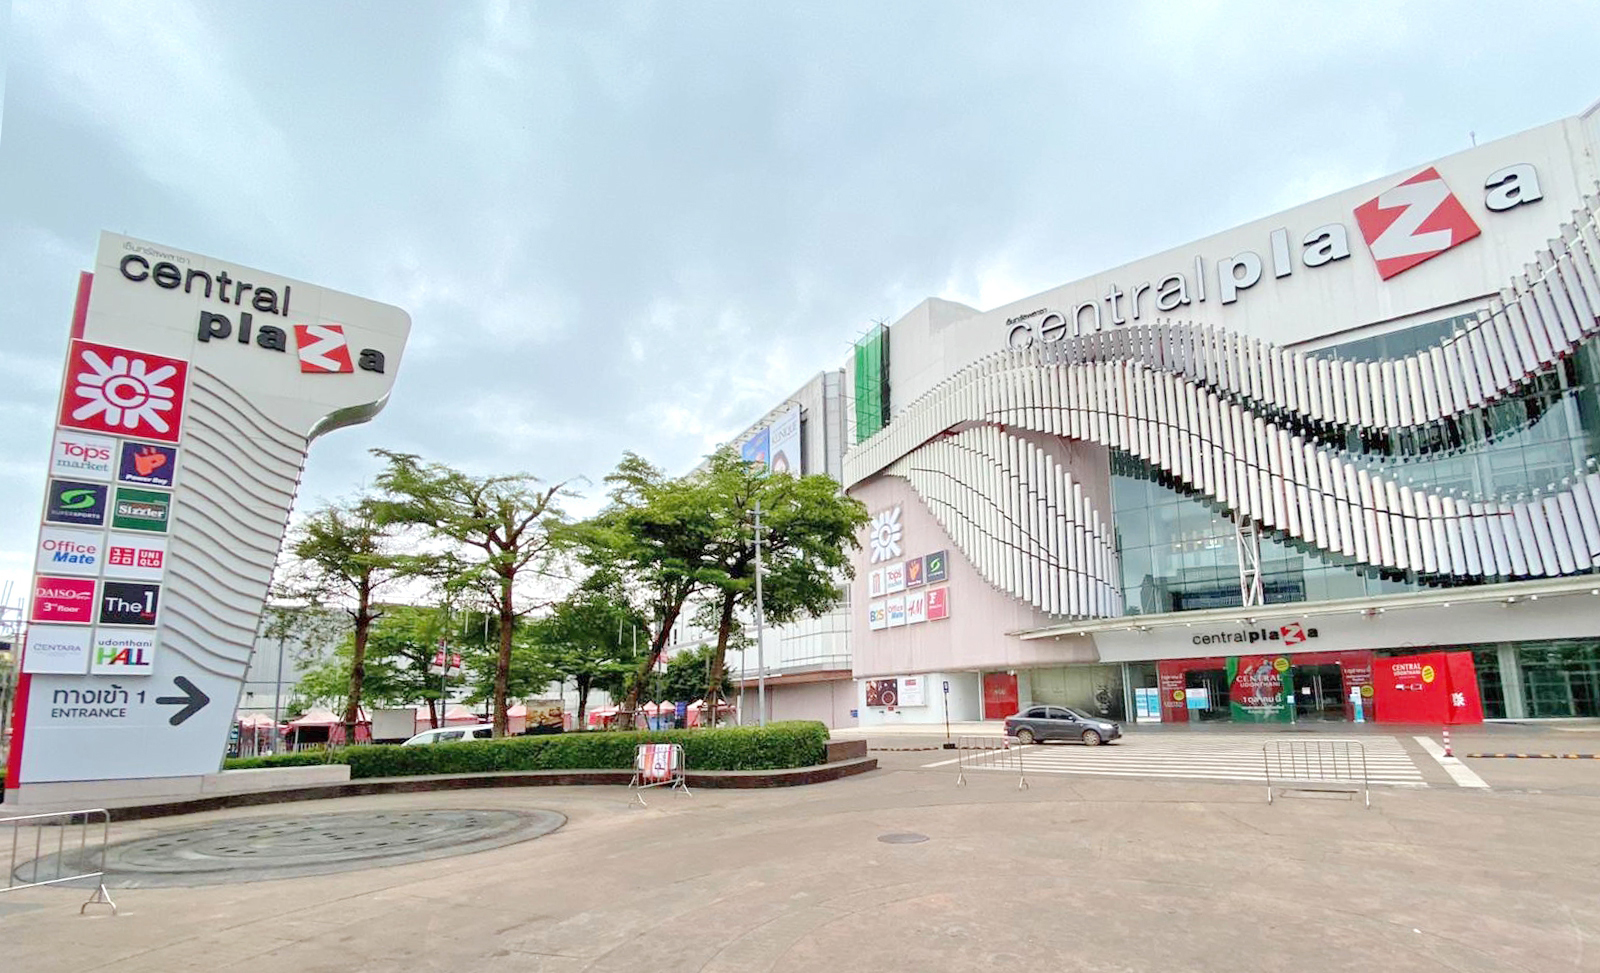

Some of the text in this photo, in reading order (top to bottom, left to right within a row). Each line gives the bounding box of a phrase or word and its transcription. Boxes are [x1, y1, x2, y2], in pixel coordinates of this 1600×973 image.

[120, 254, 291, 316] central
[60, 441, 110, 461] Tops
[57, 459, 109, 472] market
[118, 504, 165, 518] Sizzler
[42, 539, 96, 554] Office
[53, 551, 96, 565] Mate
[35, 587, 76, 599] DAISO
[33, 643, 81, 651] CENTARA
[98, 638, 152, 647] udonthani
[97, 647, 150, 666] HALL
[53, 684, 146, 704] ทางเข้า 1
[51, 708, 127, 718] ENTRANCE
